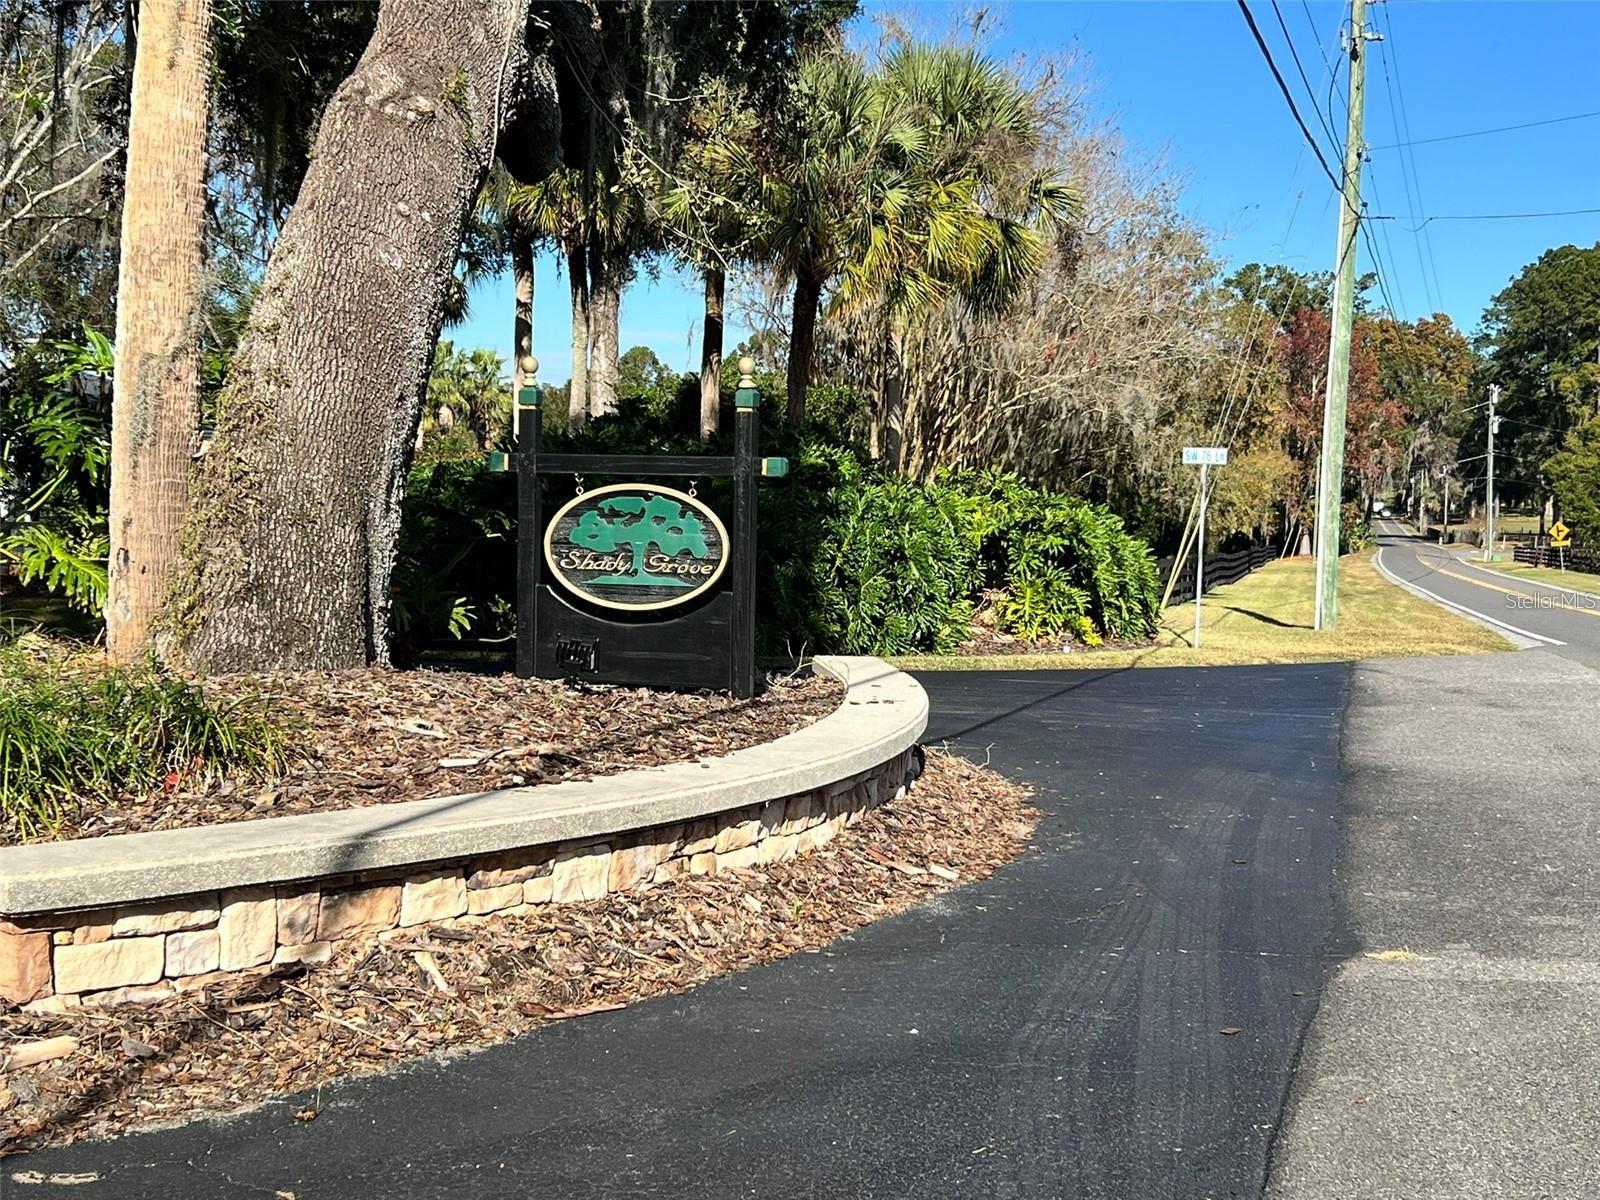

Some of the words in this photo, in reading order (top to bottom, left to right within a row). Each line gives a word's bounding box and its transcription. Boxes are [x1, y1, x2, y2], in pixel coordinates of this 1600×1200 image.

[1185, 449, 1198, 462] SW
[560, 550, 631, 576] Shady
[643, 554, 713, 574] Grove
